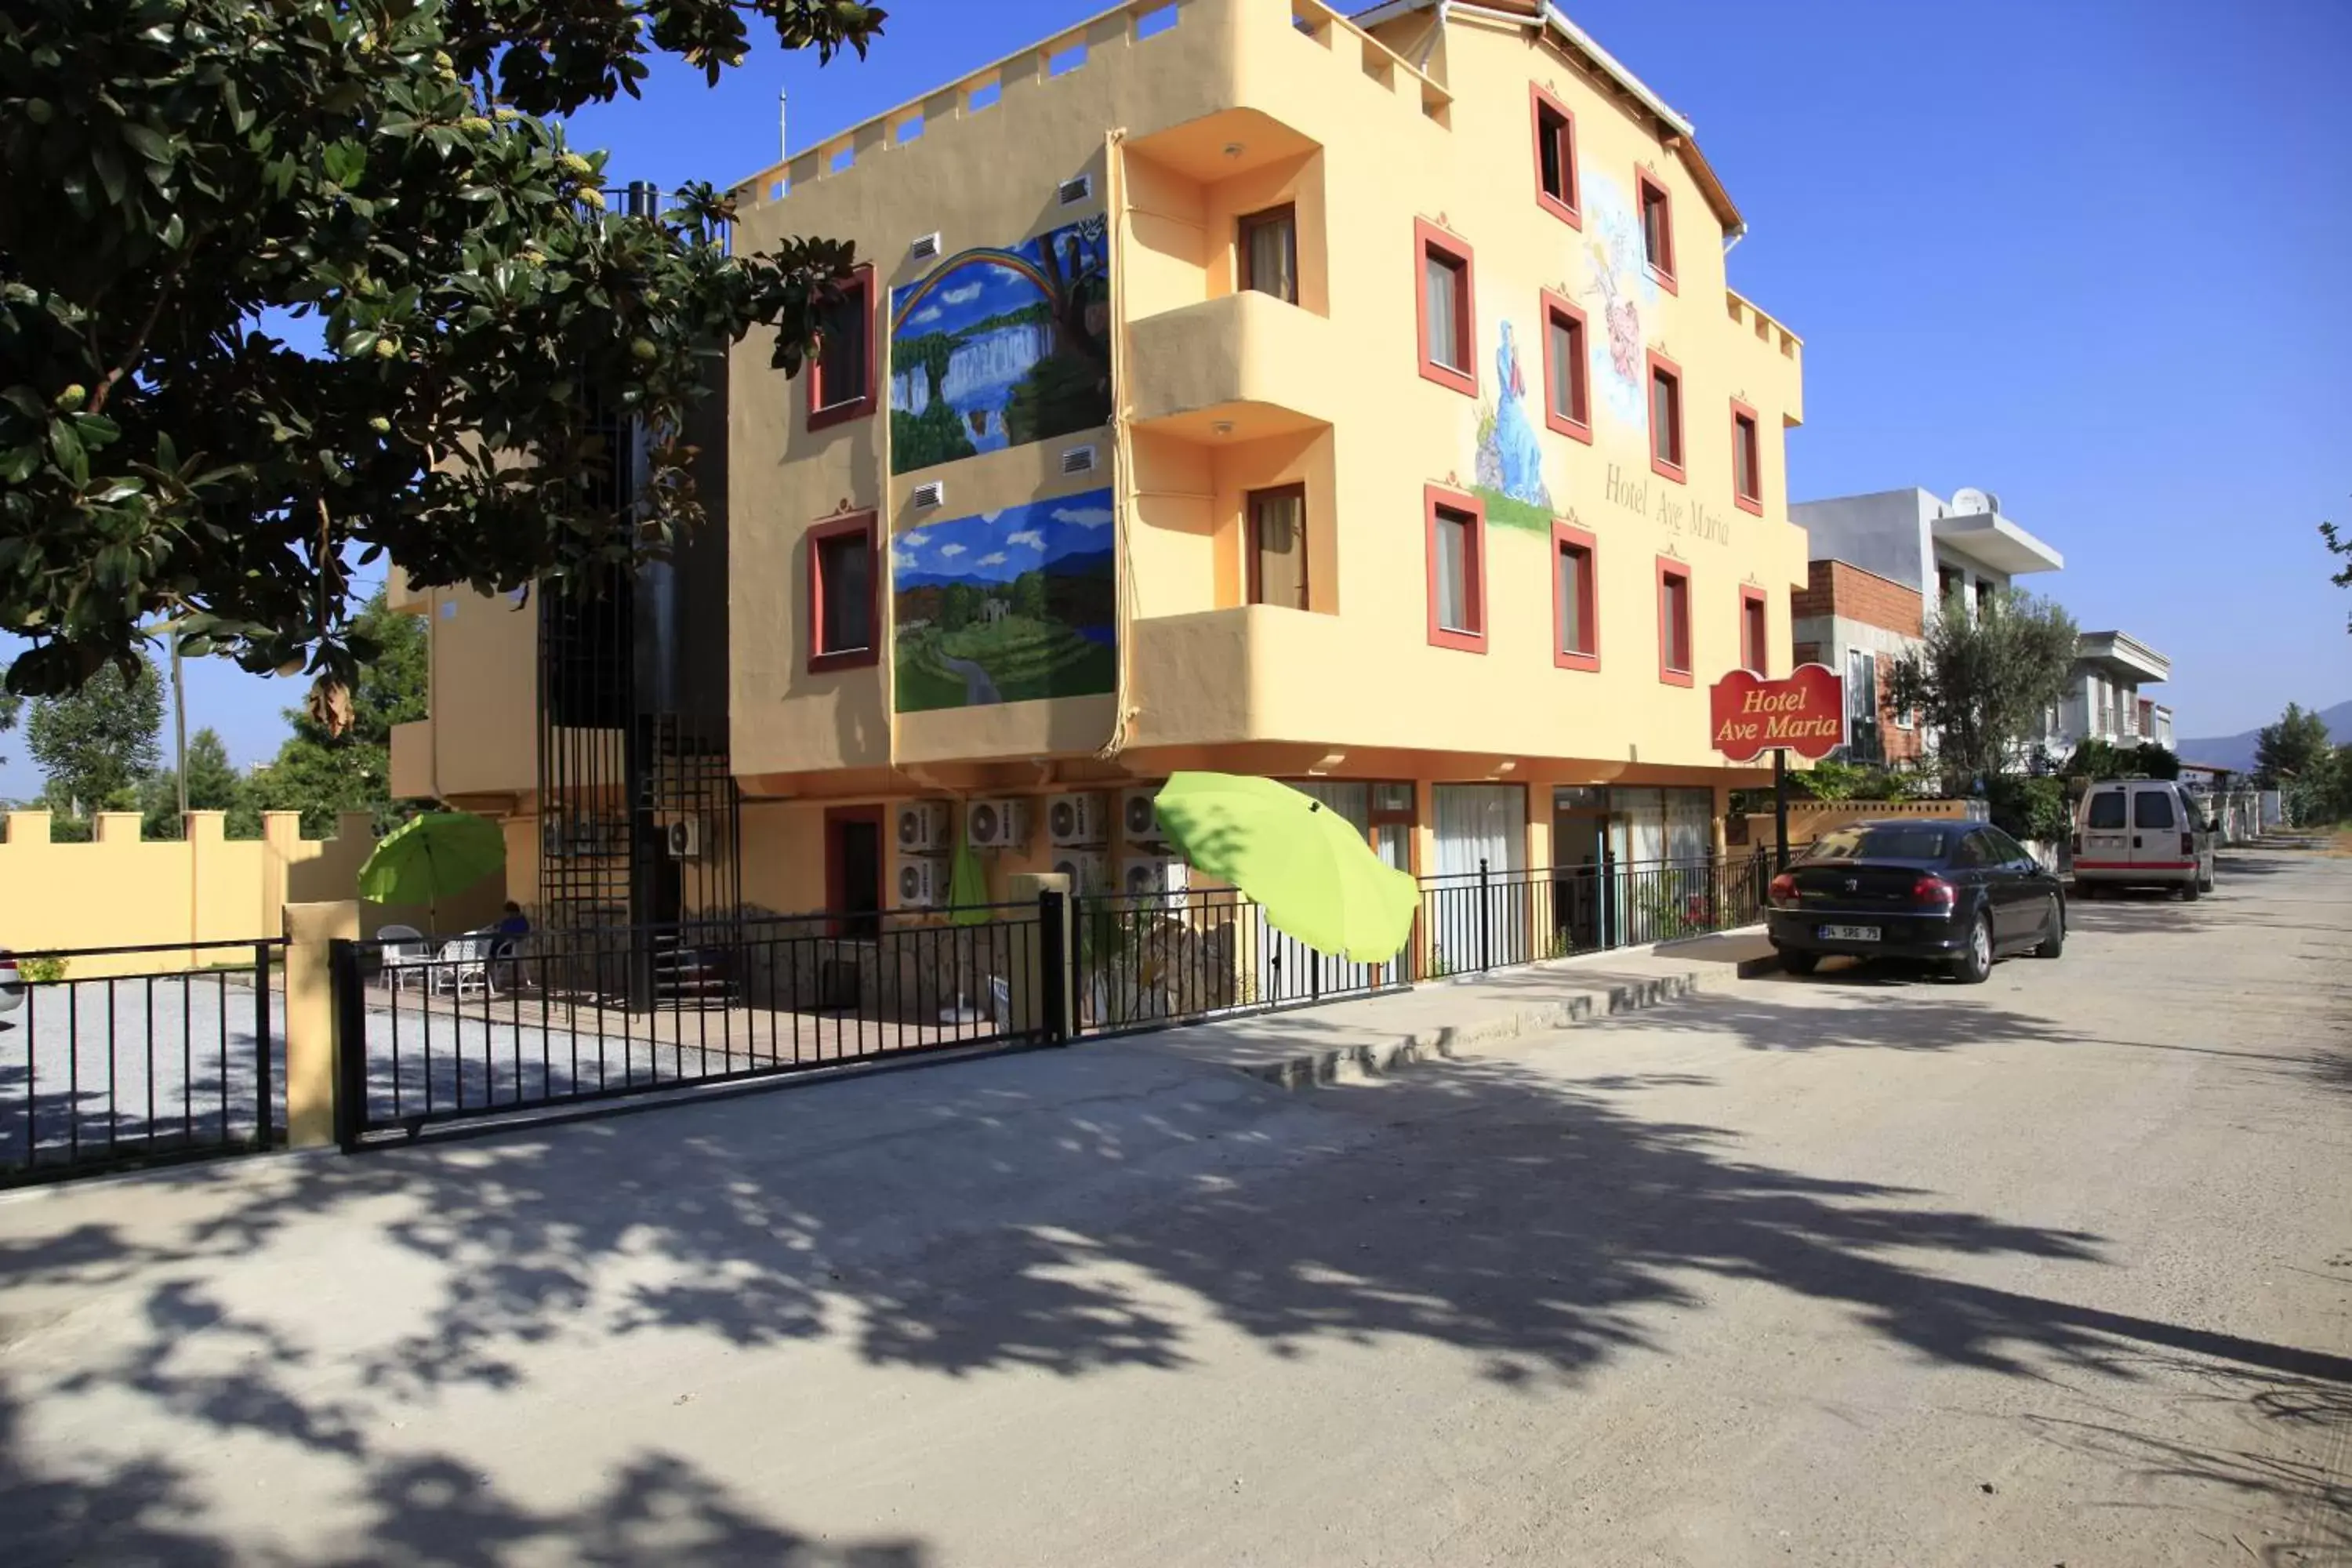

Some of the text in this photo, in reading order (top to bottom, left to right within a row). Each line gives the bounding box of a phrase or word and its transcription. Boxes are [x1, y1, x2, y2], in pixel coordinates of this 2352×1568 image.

[1606, 463, 1647, 516] Hotel
[1742, 687, 1807, 714] Hotel
[1715, 714, 1838, 741] Ave Maria
